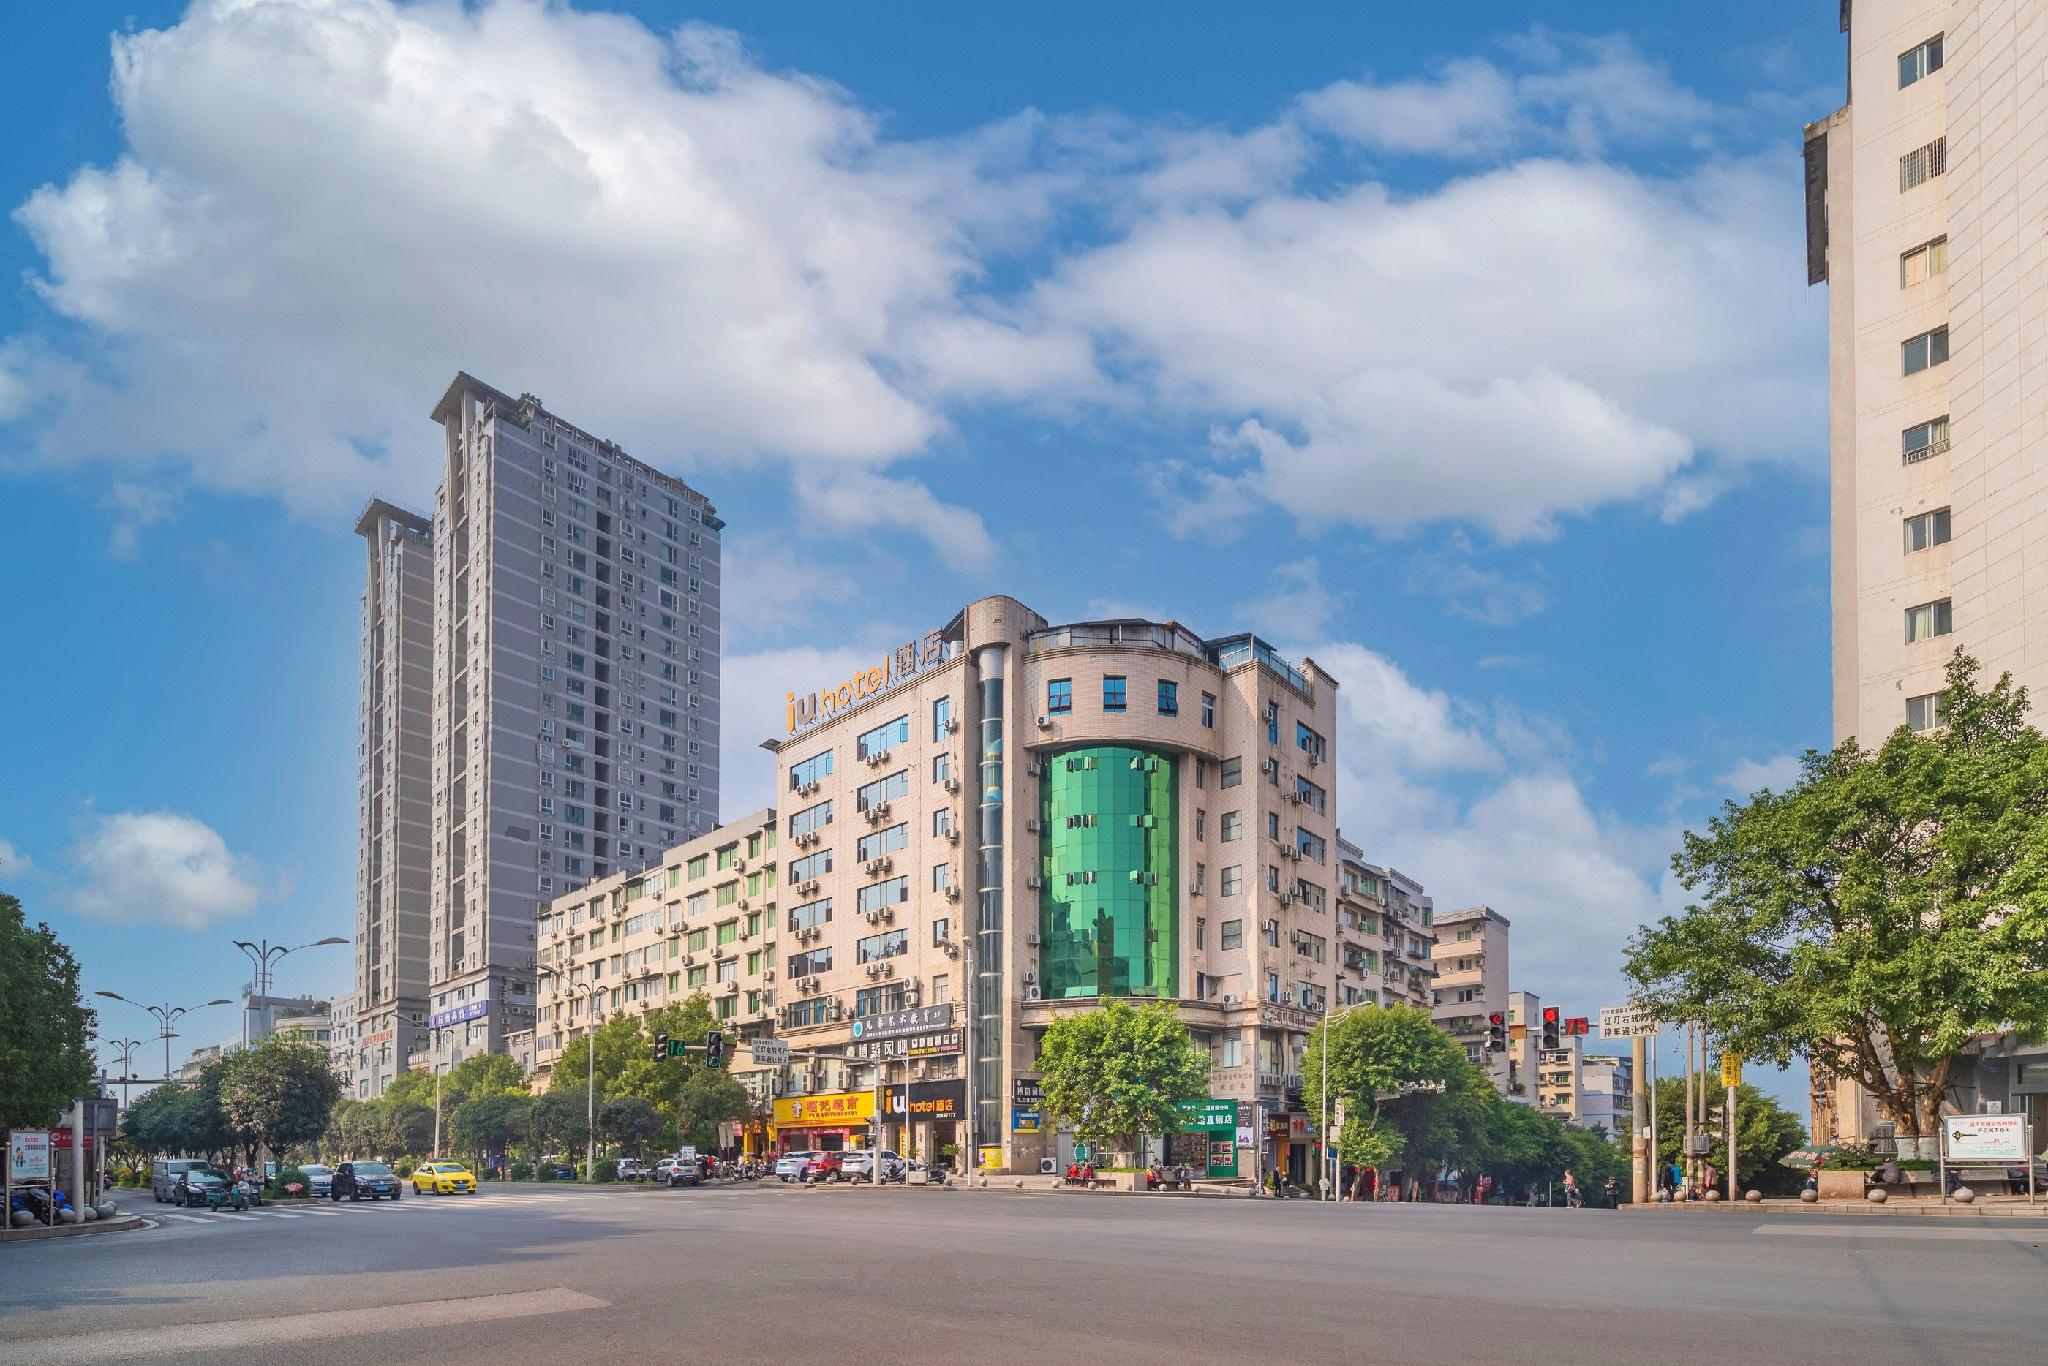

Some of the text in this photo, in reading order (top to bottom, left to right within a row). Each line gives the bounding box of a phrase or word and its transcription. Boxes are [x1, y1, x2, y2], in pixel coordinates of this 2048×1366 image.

[820, 655, 890, 717] hotel
[1566, 1018, 1587, 1034] 75
[670, 1040, 684, 1056] 16
[885, 1089, 954, 1115] iu hotel 酒店
